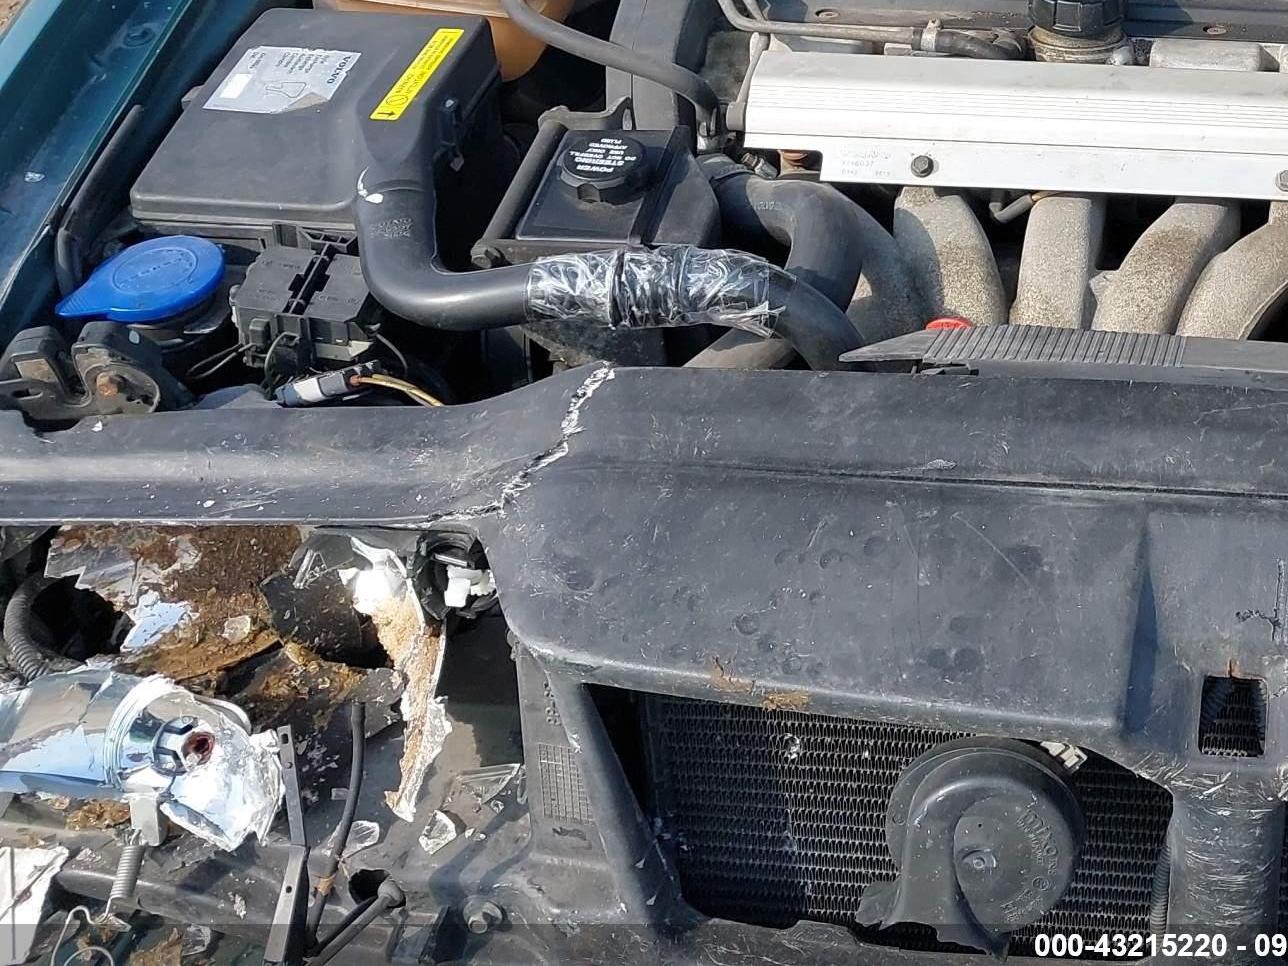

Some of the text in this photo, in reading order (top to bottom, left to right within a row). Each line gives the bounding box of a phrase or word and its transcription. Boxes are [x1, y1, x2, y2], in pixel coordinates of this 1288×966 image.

[326, 56, 351, 84] VOLVO
[569, 151, 604, 159] OVERFILL
[574, 157, 624, 166] STEERING
[576, 164, 614, 172] POWER
